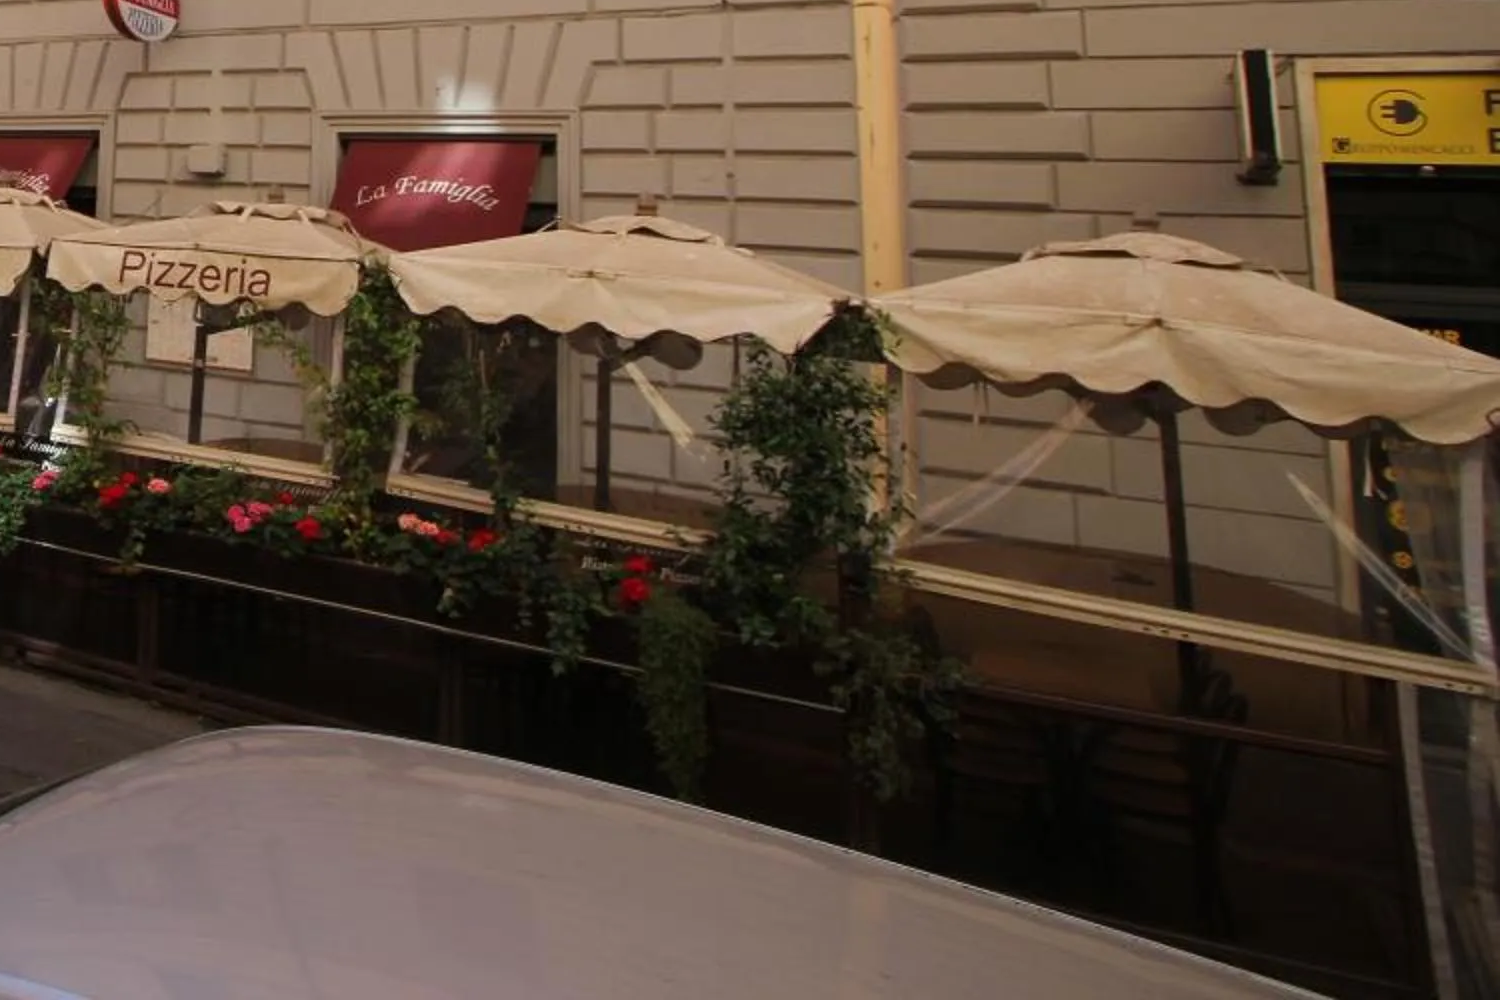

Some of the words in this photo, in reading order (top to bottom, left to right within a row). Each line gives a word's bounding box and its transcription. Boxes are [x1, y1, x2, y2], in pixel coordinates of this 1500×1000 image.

[356, 184, 387, 206] La
[395, 176, 500, 212] Famiglia
[119, 250, 271, 297] Pizzeria
